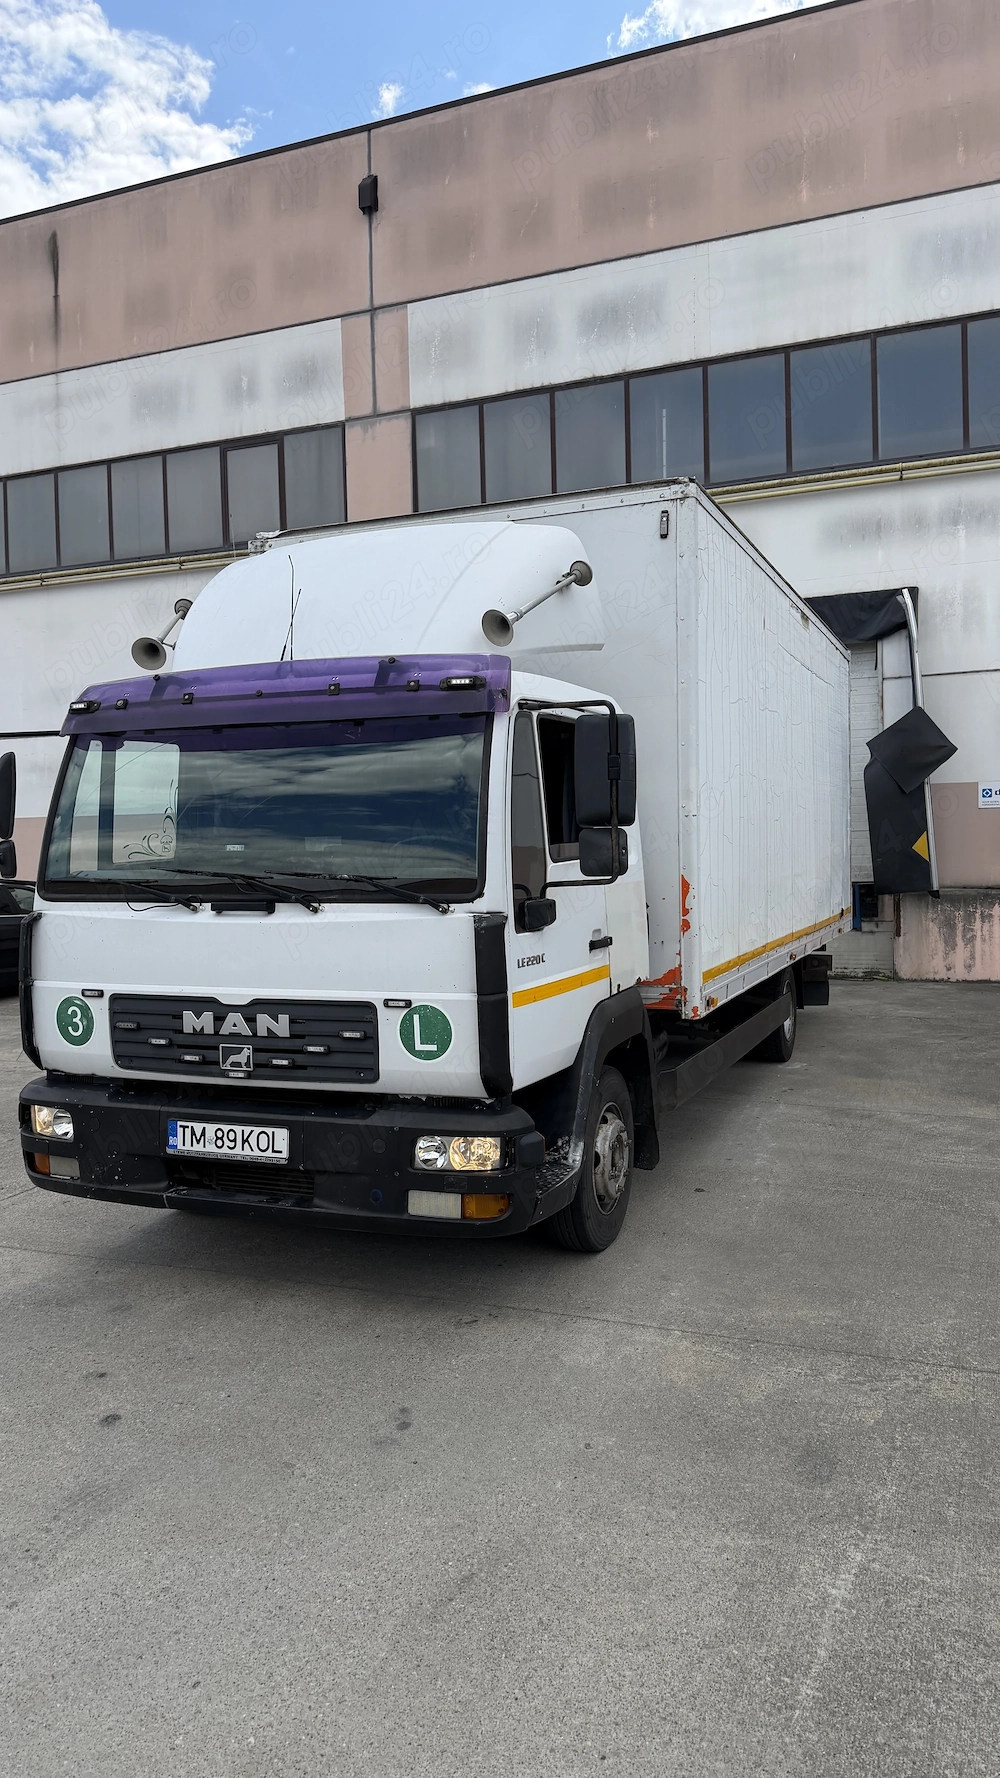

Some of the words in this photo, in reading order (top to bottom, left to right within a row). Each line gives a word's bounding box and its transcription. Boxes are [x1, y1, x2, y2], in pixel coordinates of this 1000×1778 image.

[67, 1005, 84, 1037] 3
[182, 1010, 291, 1038] MAN
[413, 1014, 438, 1051] L
[168, 1136, 178, 1146] RO
[179, 1124, 206, 1149] TM
[214, 1127, 237, 1150] 89
[241, 1129, 283, 1154] KOL
